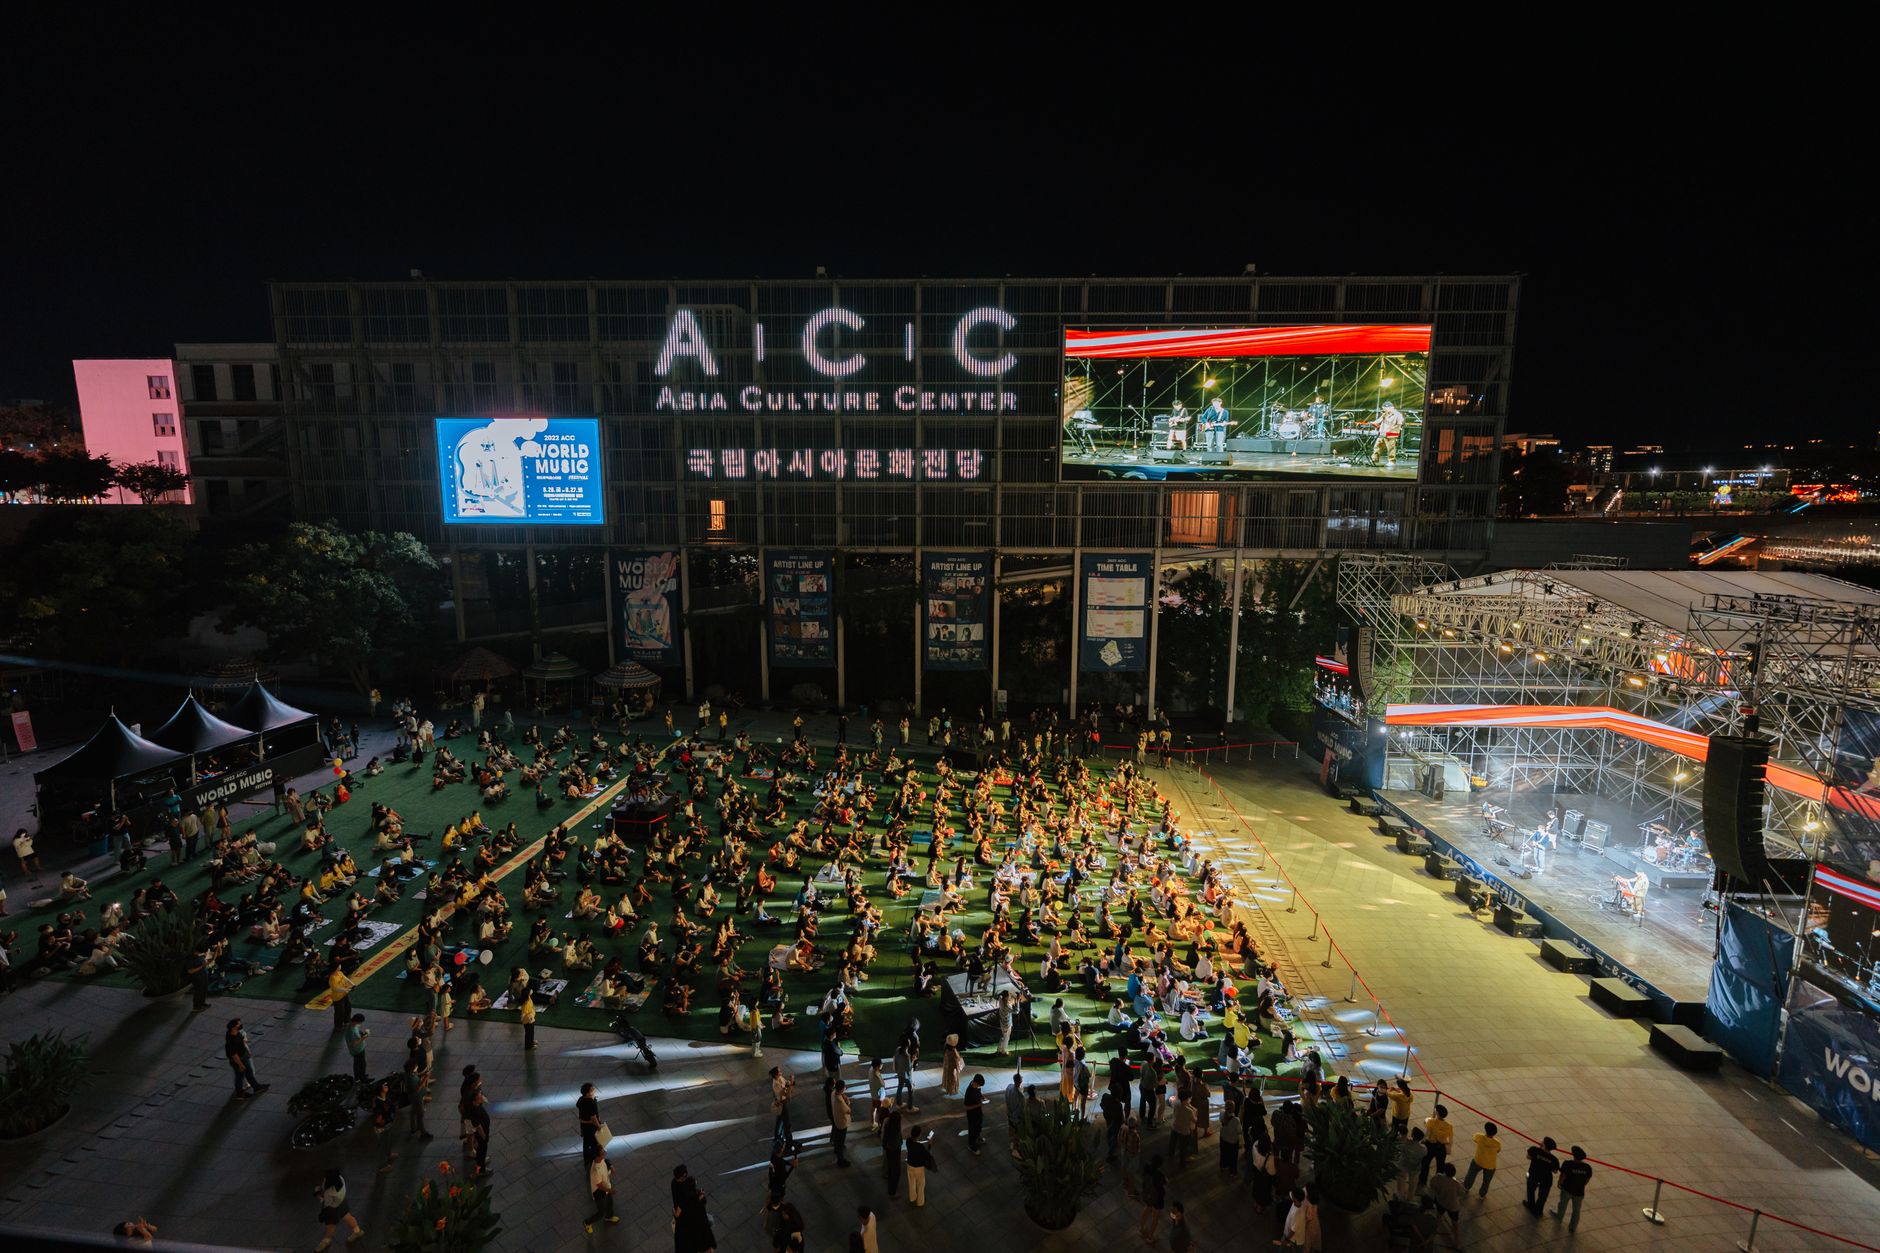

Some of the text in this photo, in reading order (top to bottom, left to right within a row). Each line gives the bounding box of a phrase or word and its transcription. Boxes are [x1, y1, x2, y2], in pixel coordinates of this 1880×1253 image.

[536, 444, 589, 458] WORLD
[535, 459, 589, 474] MUSIC
[687, 447, 983, 479] 국립아시아문화전당
[931, 562, 954, 570] ARTIST
[956, 563, 972, 571] LINE
[1097, 563, 1137, 572] TIME TABLE
[196, 768, 273, 805] WORLD MUSIC
